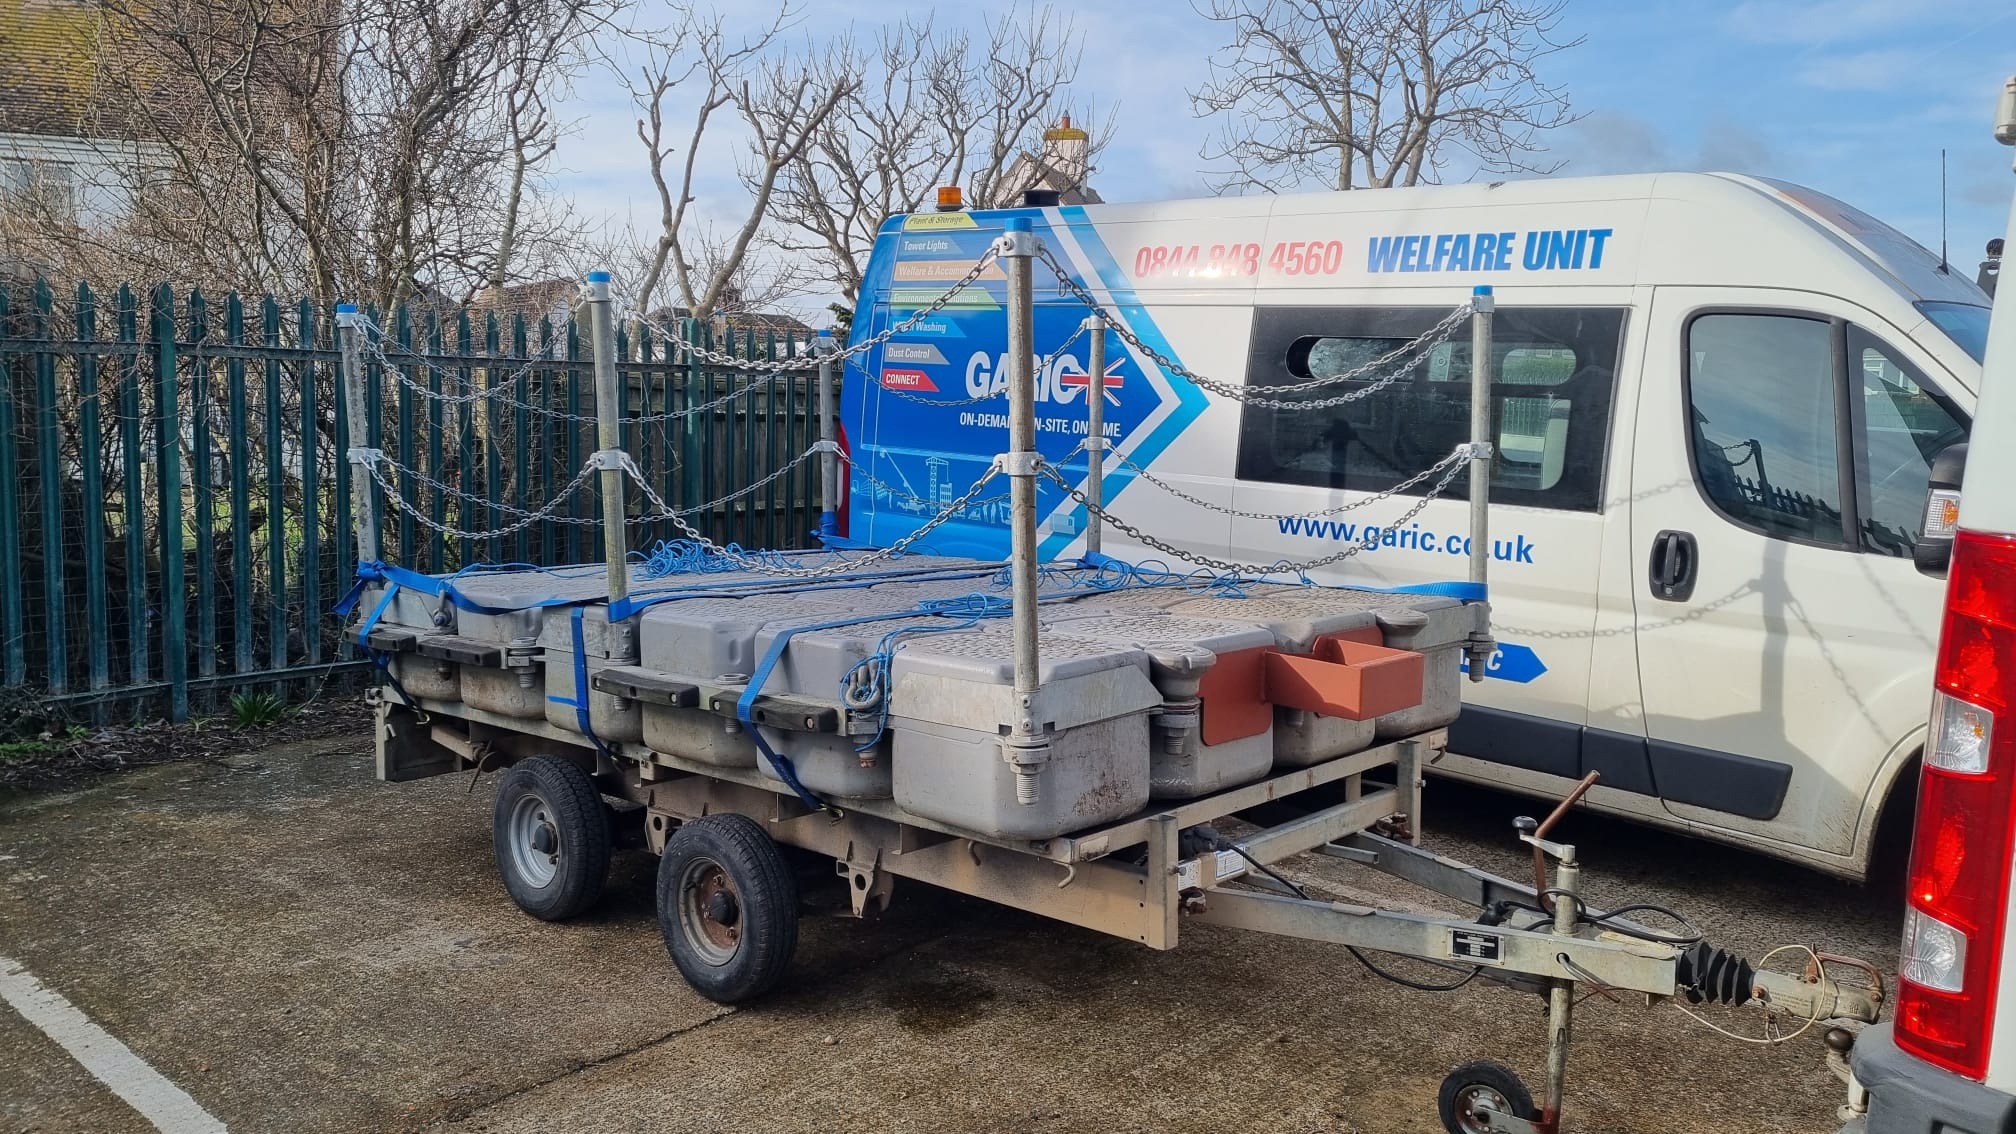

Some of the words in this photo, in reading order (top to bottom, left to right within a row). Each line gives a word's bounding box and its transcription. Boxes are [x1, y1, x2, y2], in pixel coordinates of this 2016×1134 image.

[909, 217, 928, 225] Plant
[936, 215, 964, 225] Storage
[904, 240, 926, 251] Tower
[927, 240, 949, 252] Lights
[1367, 231, 1517, 273] WELFARE
[1523, 228, 1613, 271] UNIT
[1135, 245, 1200, 278] 0844
[1268, 240, 1344, 275] 4560
[899, 265, 926, 276] Welfare
[915, 321, 947, 335] Washing
[888, 347, 904, 358] Dust
[905, 348, 930, 359] Control
[886, 373, 920, 385] CONNECT
[1031, 416, 1071, 435] N-SITE,
